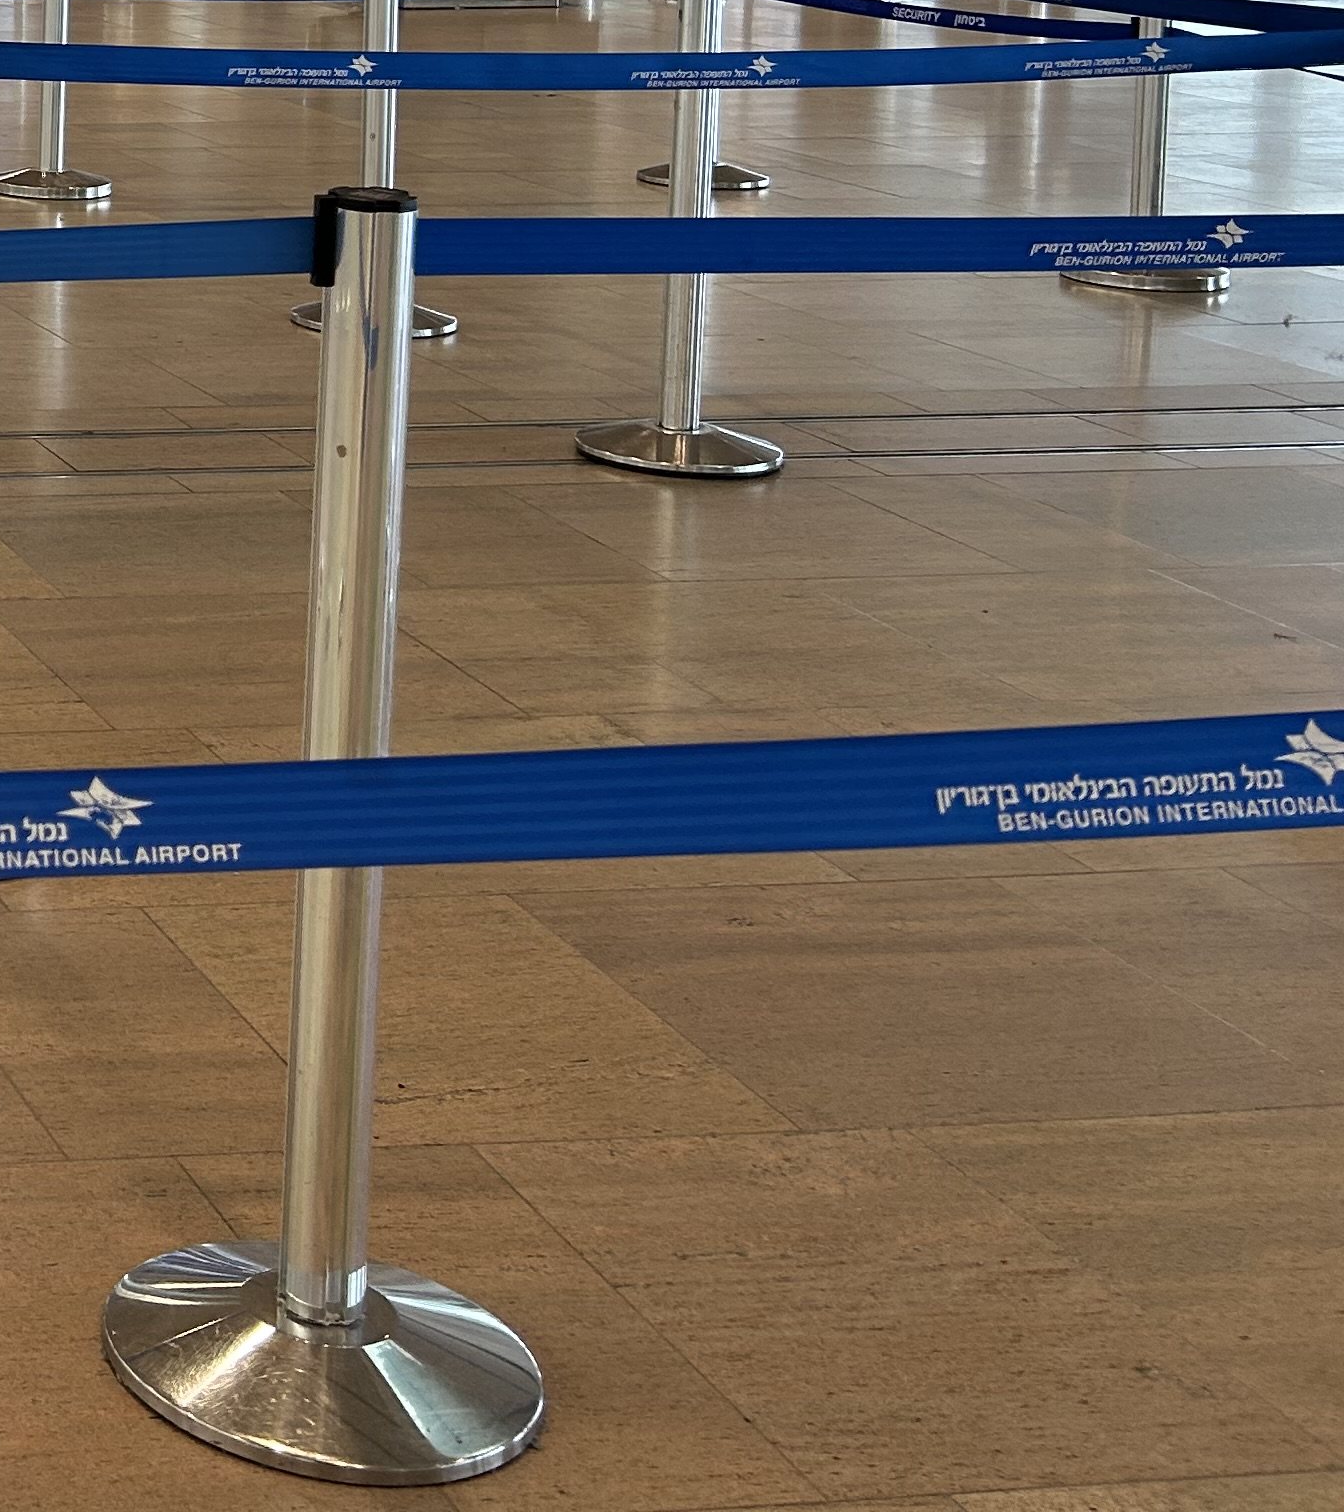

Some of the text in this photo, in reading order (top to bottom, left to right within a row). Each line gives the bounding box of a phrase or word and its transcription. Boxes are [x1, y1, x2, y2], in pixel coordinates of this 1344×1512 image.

[892, 6, 941, 23] SECURITY
[954, 13, 986, 27] ביטחון
[1055, 252, 1285, 266] BEN-GURION INTERNATIONAL AIRPORT
[1025, 773, 1138, 802] הבינלאומי
[1143, 768, 1235, 797] התעופה
[1240, 763, 1285, 790] נמל
[998, 794, 1344, 832] BEN-GURION INTERNATIONAL
[23, 817, 68, 843] נמל
[134, 842, 242, 865] AIRPORT
